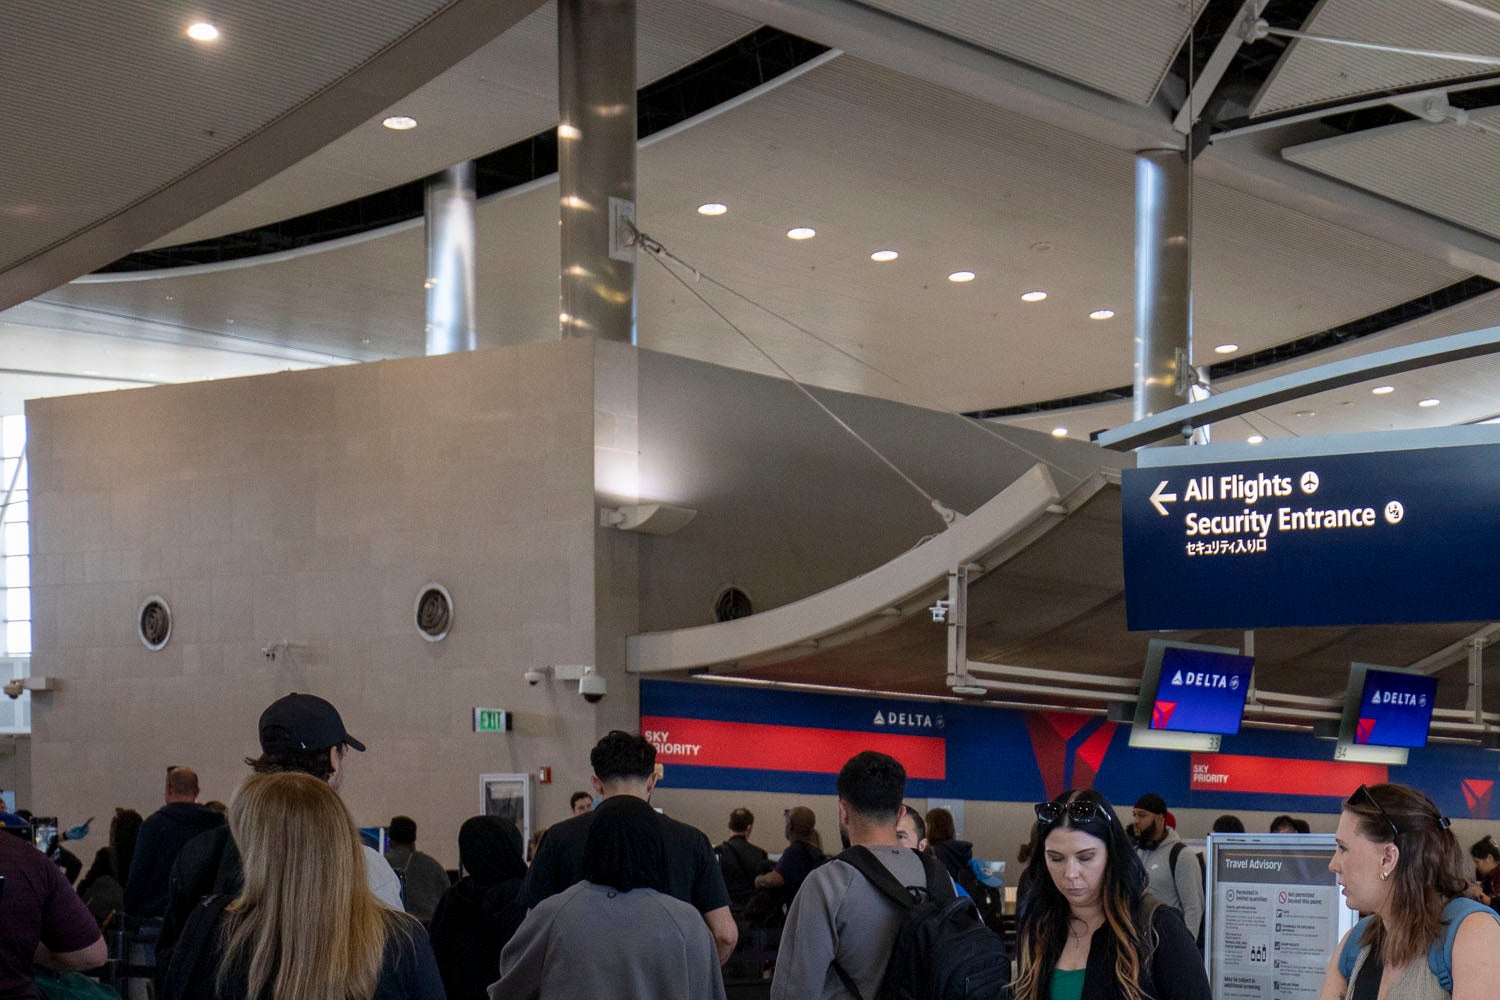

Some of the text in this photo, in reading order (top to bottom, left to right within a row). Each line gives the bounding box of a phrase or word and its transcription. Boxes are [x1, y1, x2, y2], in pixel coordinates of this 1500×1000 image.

[1185, 473, 1292, 503] All Flights
[1186, 508, 1375, 537] Security Entrance
[1186, 536, 1266, 555] セキュリティ入り口
[1186, 671, 1227, 688] DELTA
[1383, 691, 1417, 706] DELTA
[480, 711, 502, 729] EXIT
[887, 711, 933, 728] DELTA
[645, 730, 669, 743] SKY
[653, 743, 701, 756] RIORITY
[1193, 764, 1209, 773] SKY
[1193, 773, 1229, 783] PRIORITY
[1225, 859, 1282, 871] Travel Advisory
